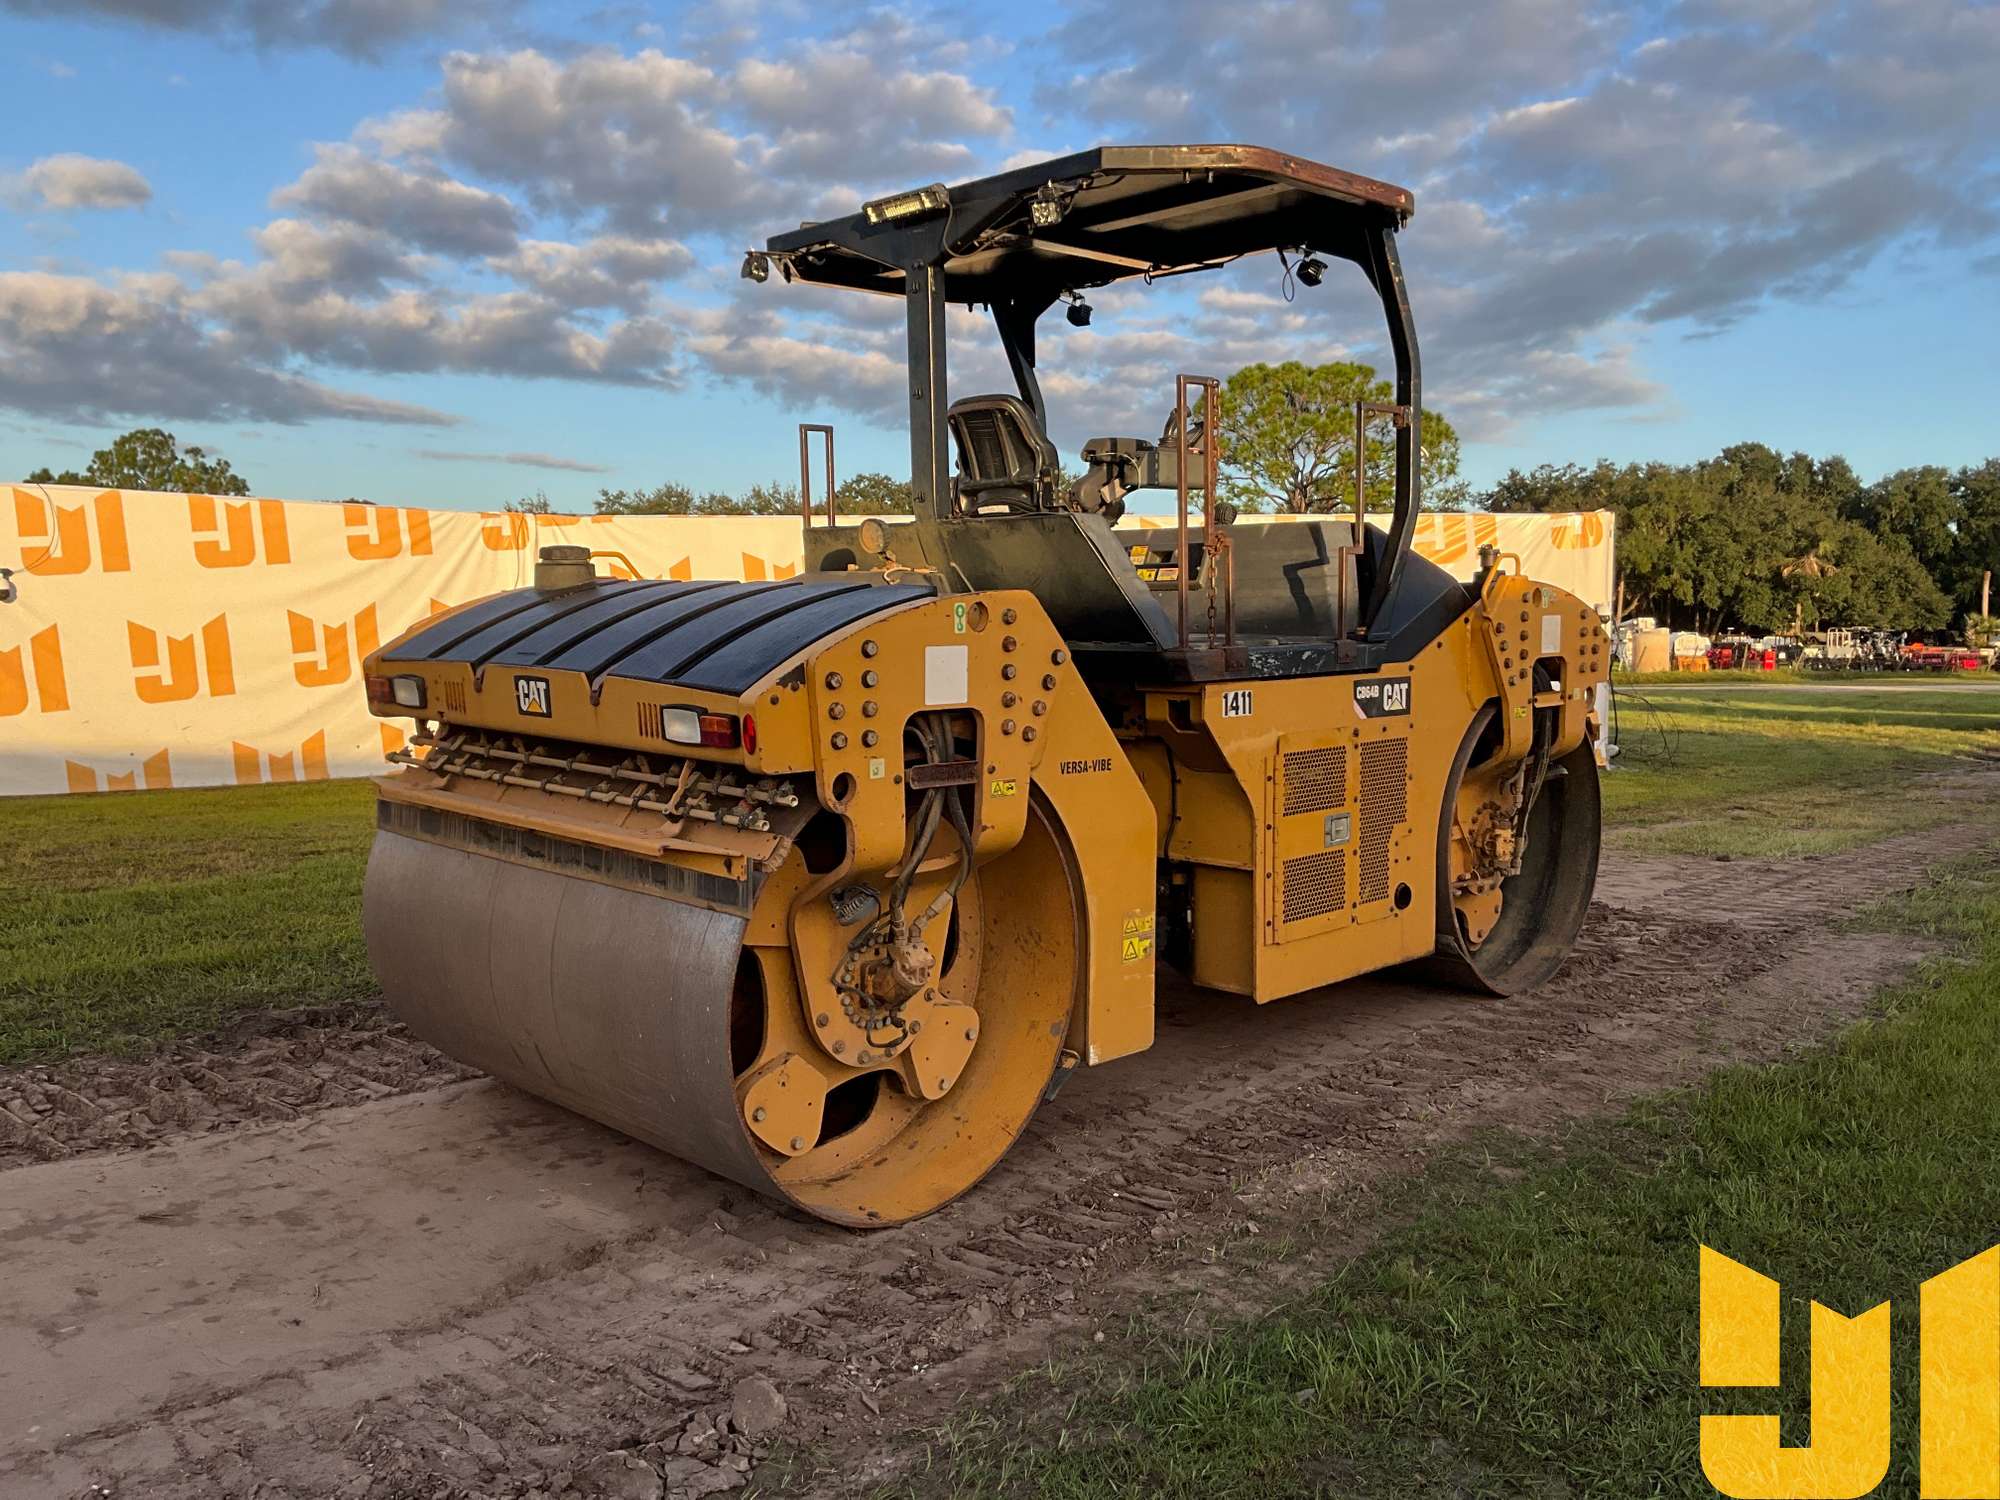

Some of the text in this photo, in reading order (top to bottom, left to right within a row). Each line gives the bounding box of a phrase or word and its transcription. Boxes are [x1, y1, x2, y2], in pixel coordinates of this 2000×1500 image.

[518, 679, 547, 714] CAT
[1223, 691, 1252, 717] 1411
[1383, 682, 1409, 711] CAT
[1060, 758, 1112, 775] VERSA-VIBE
